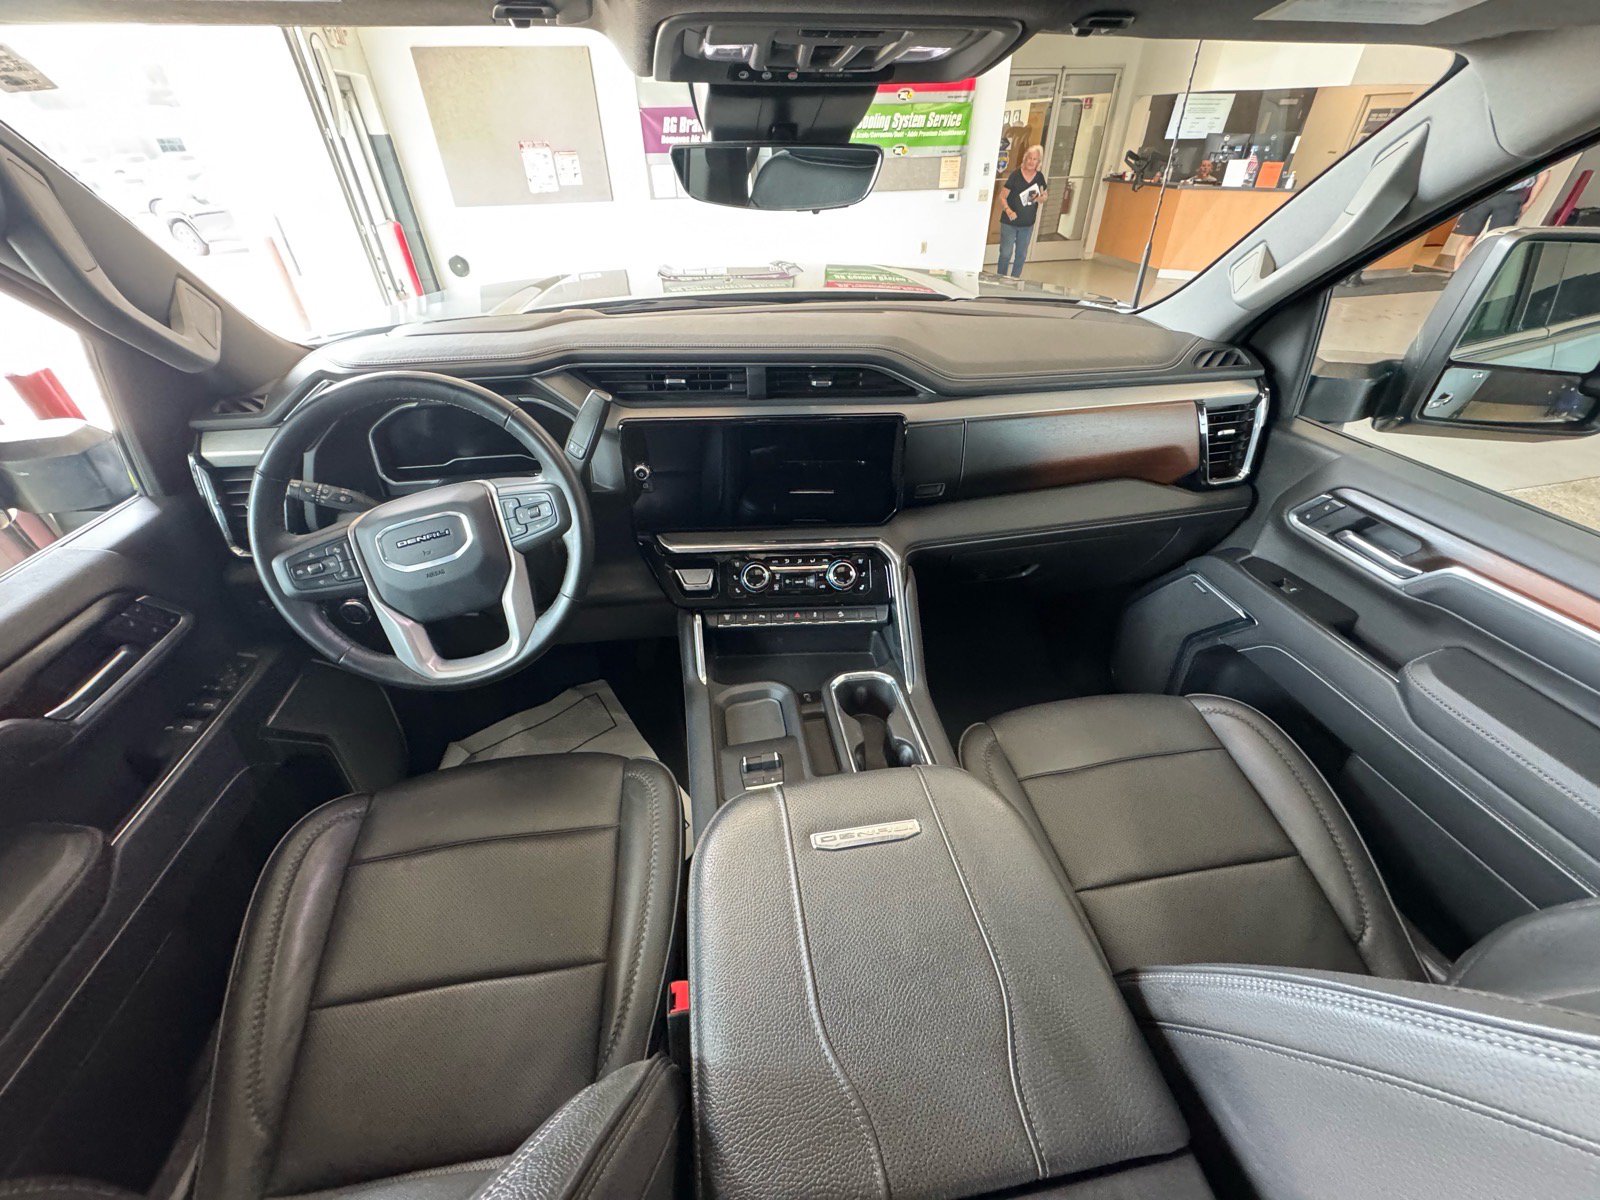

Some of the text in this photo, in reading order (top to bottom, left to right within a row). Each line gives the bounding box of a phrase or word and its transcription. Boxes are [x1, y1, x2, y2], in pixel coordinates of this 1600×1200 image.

[856, 111, 962, 131] ooling System Service
[396, 528, 450, 548] DENALI
